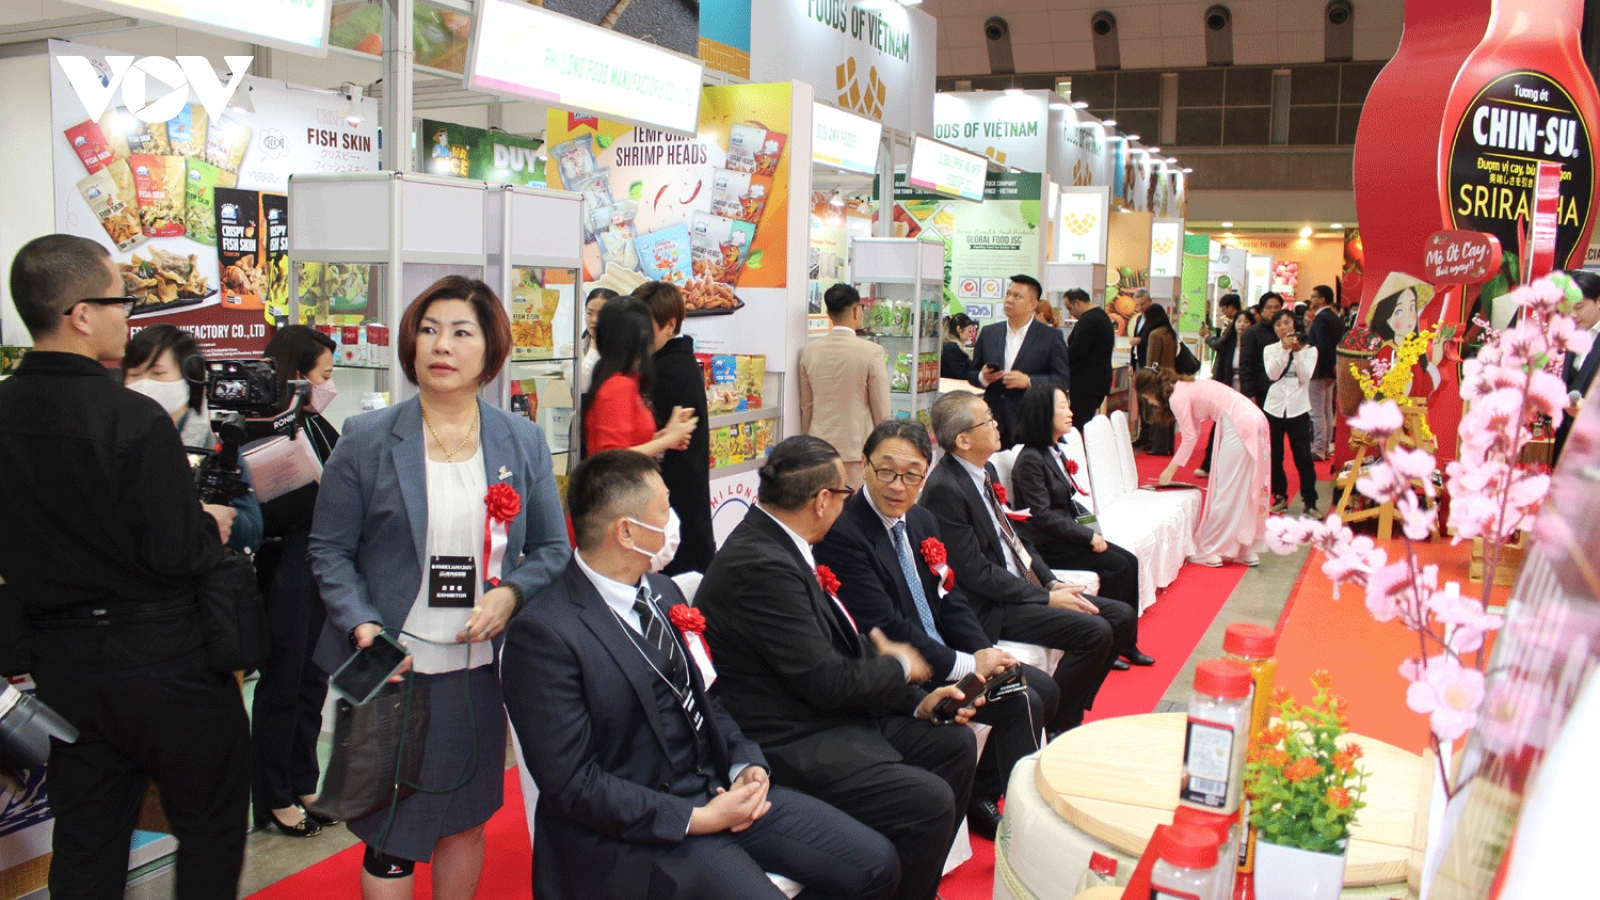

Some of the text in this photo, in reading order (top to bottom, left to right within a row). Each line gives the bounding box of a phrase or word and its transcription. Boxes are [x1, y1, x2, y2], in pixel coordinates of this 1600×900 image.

[852, 5, 865, 41] OF
[543, 48, 560, 72] PHI
[562, 52, 585, 78] LONG
[586, 60, 608, 85] FOOD
[307, 127, 371, 152] FISH SKIN
[633, 126, 690, 143] TEMP
[936, 123, 959, 139] ODS
[964, 123, 979, 138] OF
[1473, 105, 1577, 158] CHIN-SU
[494, 143, 537, 174] DUY
[616, 143, 707, 167] SHRIMP HEADS
[1510, 163, 1525, 176] cay,
[1458, 184, 1579, 227] SRIRAHA
[222, 225, 245, 238] CRISPY
[966, 235, 1023, 245] GLOBAL FOOD JSC
[223, 237, 257, 252] FISH SKIN
[1270, 241, 1287, 249] Bulk
[966, 305, 991, 316] FDA
[273, 413, 296, 430] RONIN
[710, 483, 759, 509] HI LONG
